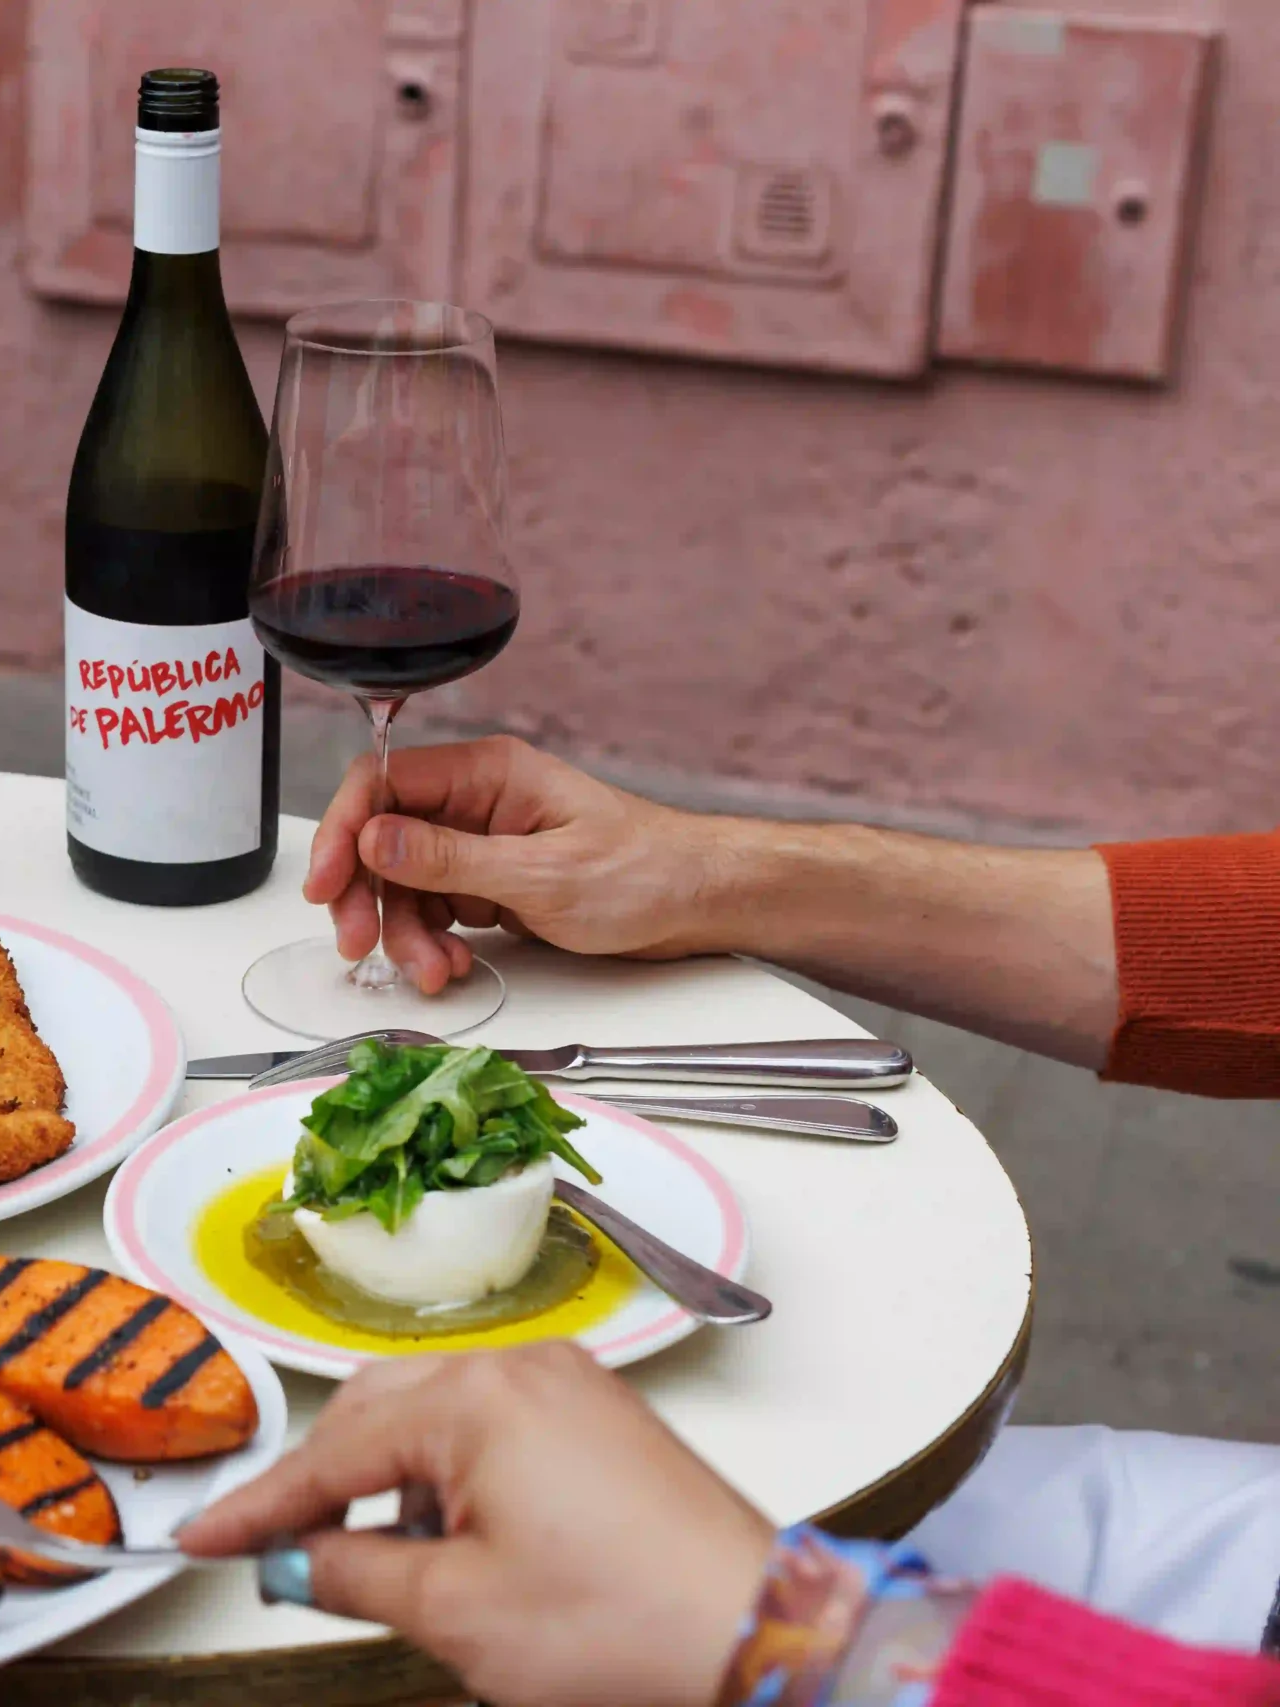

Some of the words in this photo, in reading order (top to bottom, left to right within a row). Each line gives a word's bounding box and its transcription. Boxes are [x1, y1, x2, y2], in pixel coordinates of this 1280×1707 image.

[79, 647, 241, 698] REPÚBLICA
[70, 706, 88, 734] DE
[94, 681, 264, 750] PALERMO
